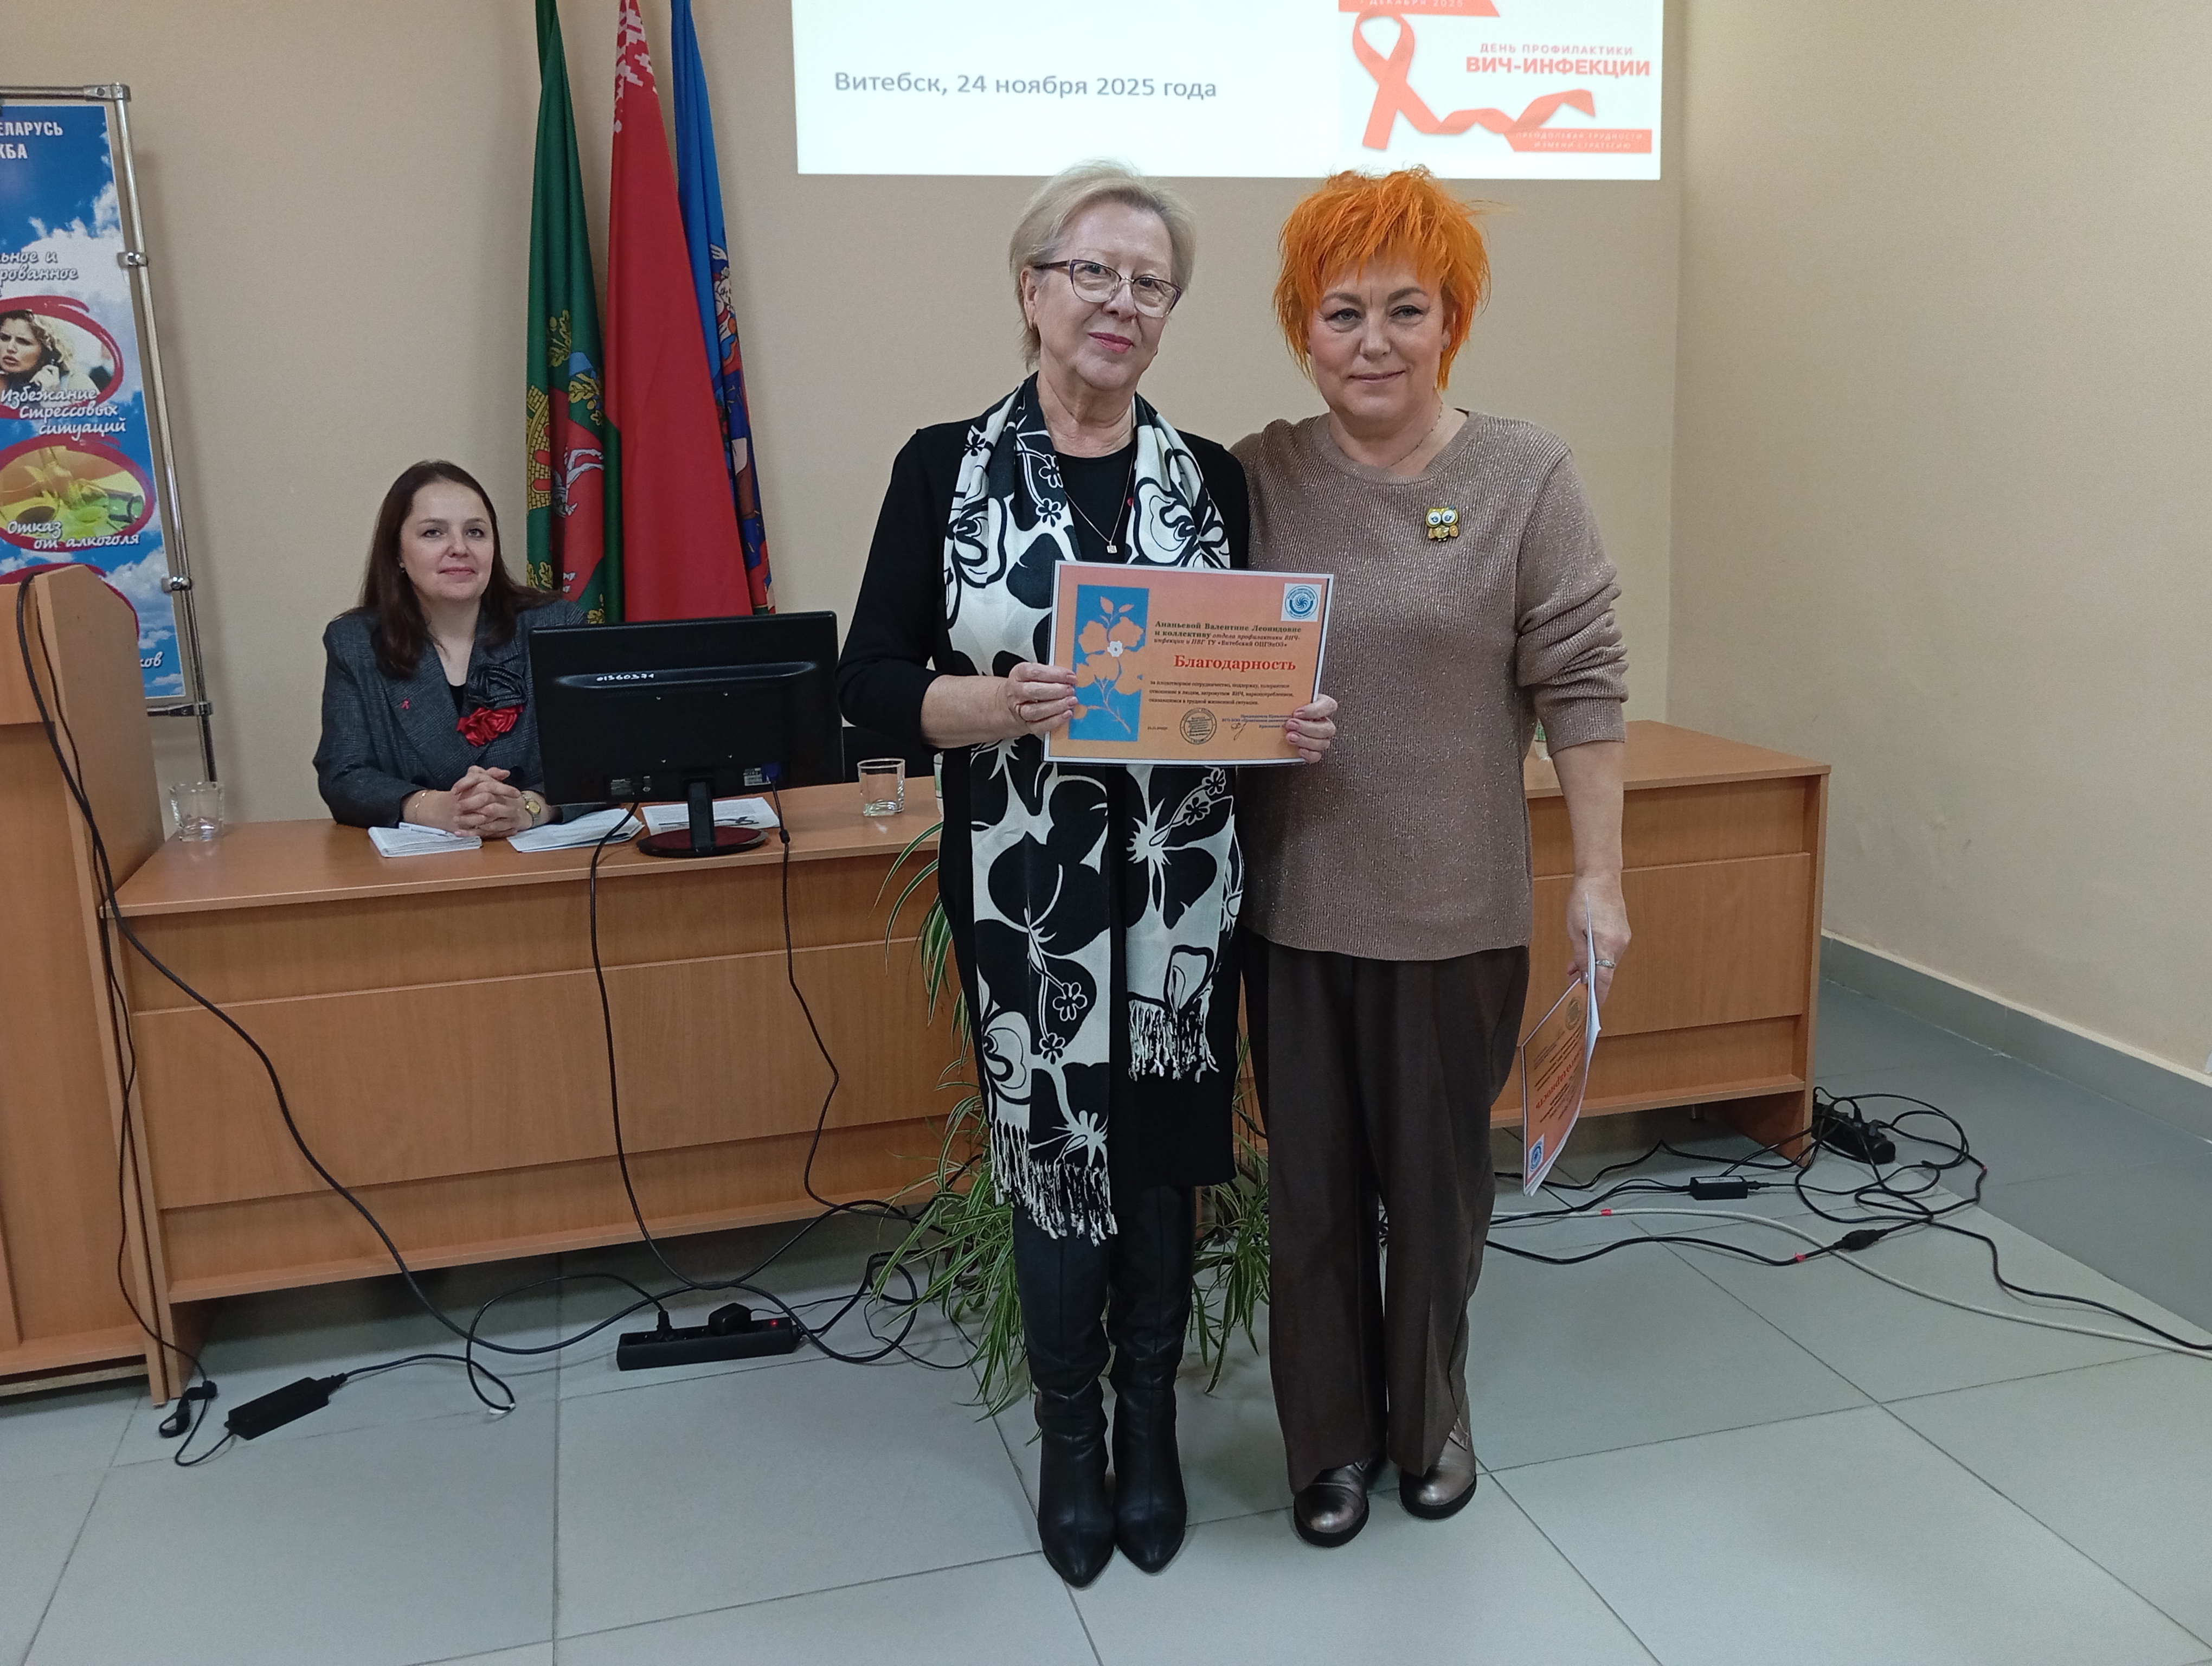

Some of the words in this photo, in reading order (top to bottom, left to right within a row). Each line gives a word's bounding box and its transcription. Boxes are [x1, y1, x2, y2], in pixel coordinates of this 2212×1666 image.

[1480, 43, 1516, 53] ДЕНЬ
[1523, 44, 1633, 55] ПРОФИЛАКТИКИ
[1466, 56, 1650, 78] ВИЧ-ИНФЕКЦИИ
[835, 72, 948, 95] Витебск,
[957, 75, 987, 93] 24
[996, 76, 1087, 99] ноября
[1097, 78, 1155, 95] 2025
[1165, 80, 1217, 100] года
[46, 252, 57, 263] и
[1, 386, 98, 408] Избежание
[20, 401, 118, 423] Стрессовых
[38, 418, 126, 441] ситуаций
[7, 521, 62, 538] Отказ
[34, 539, 58, 549] от
[66, 534, 140, 547] алкоголя
[1155, 621, 1201, 629] Ананьевой
[1162, 631, 1211, 639] коллективу
[1174, 655, 1296, 672] Благодарность
